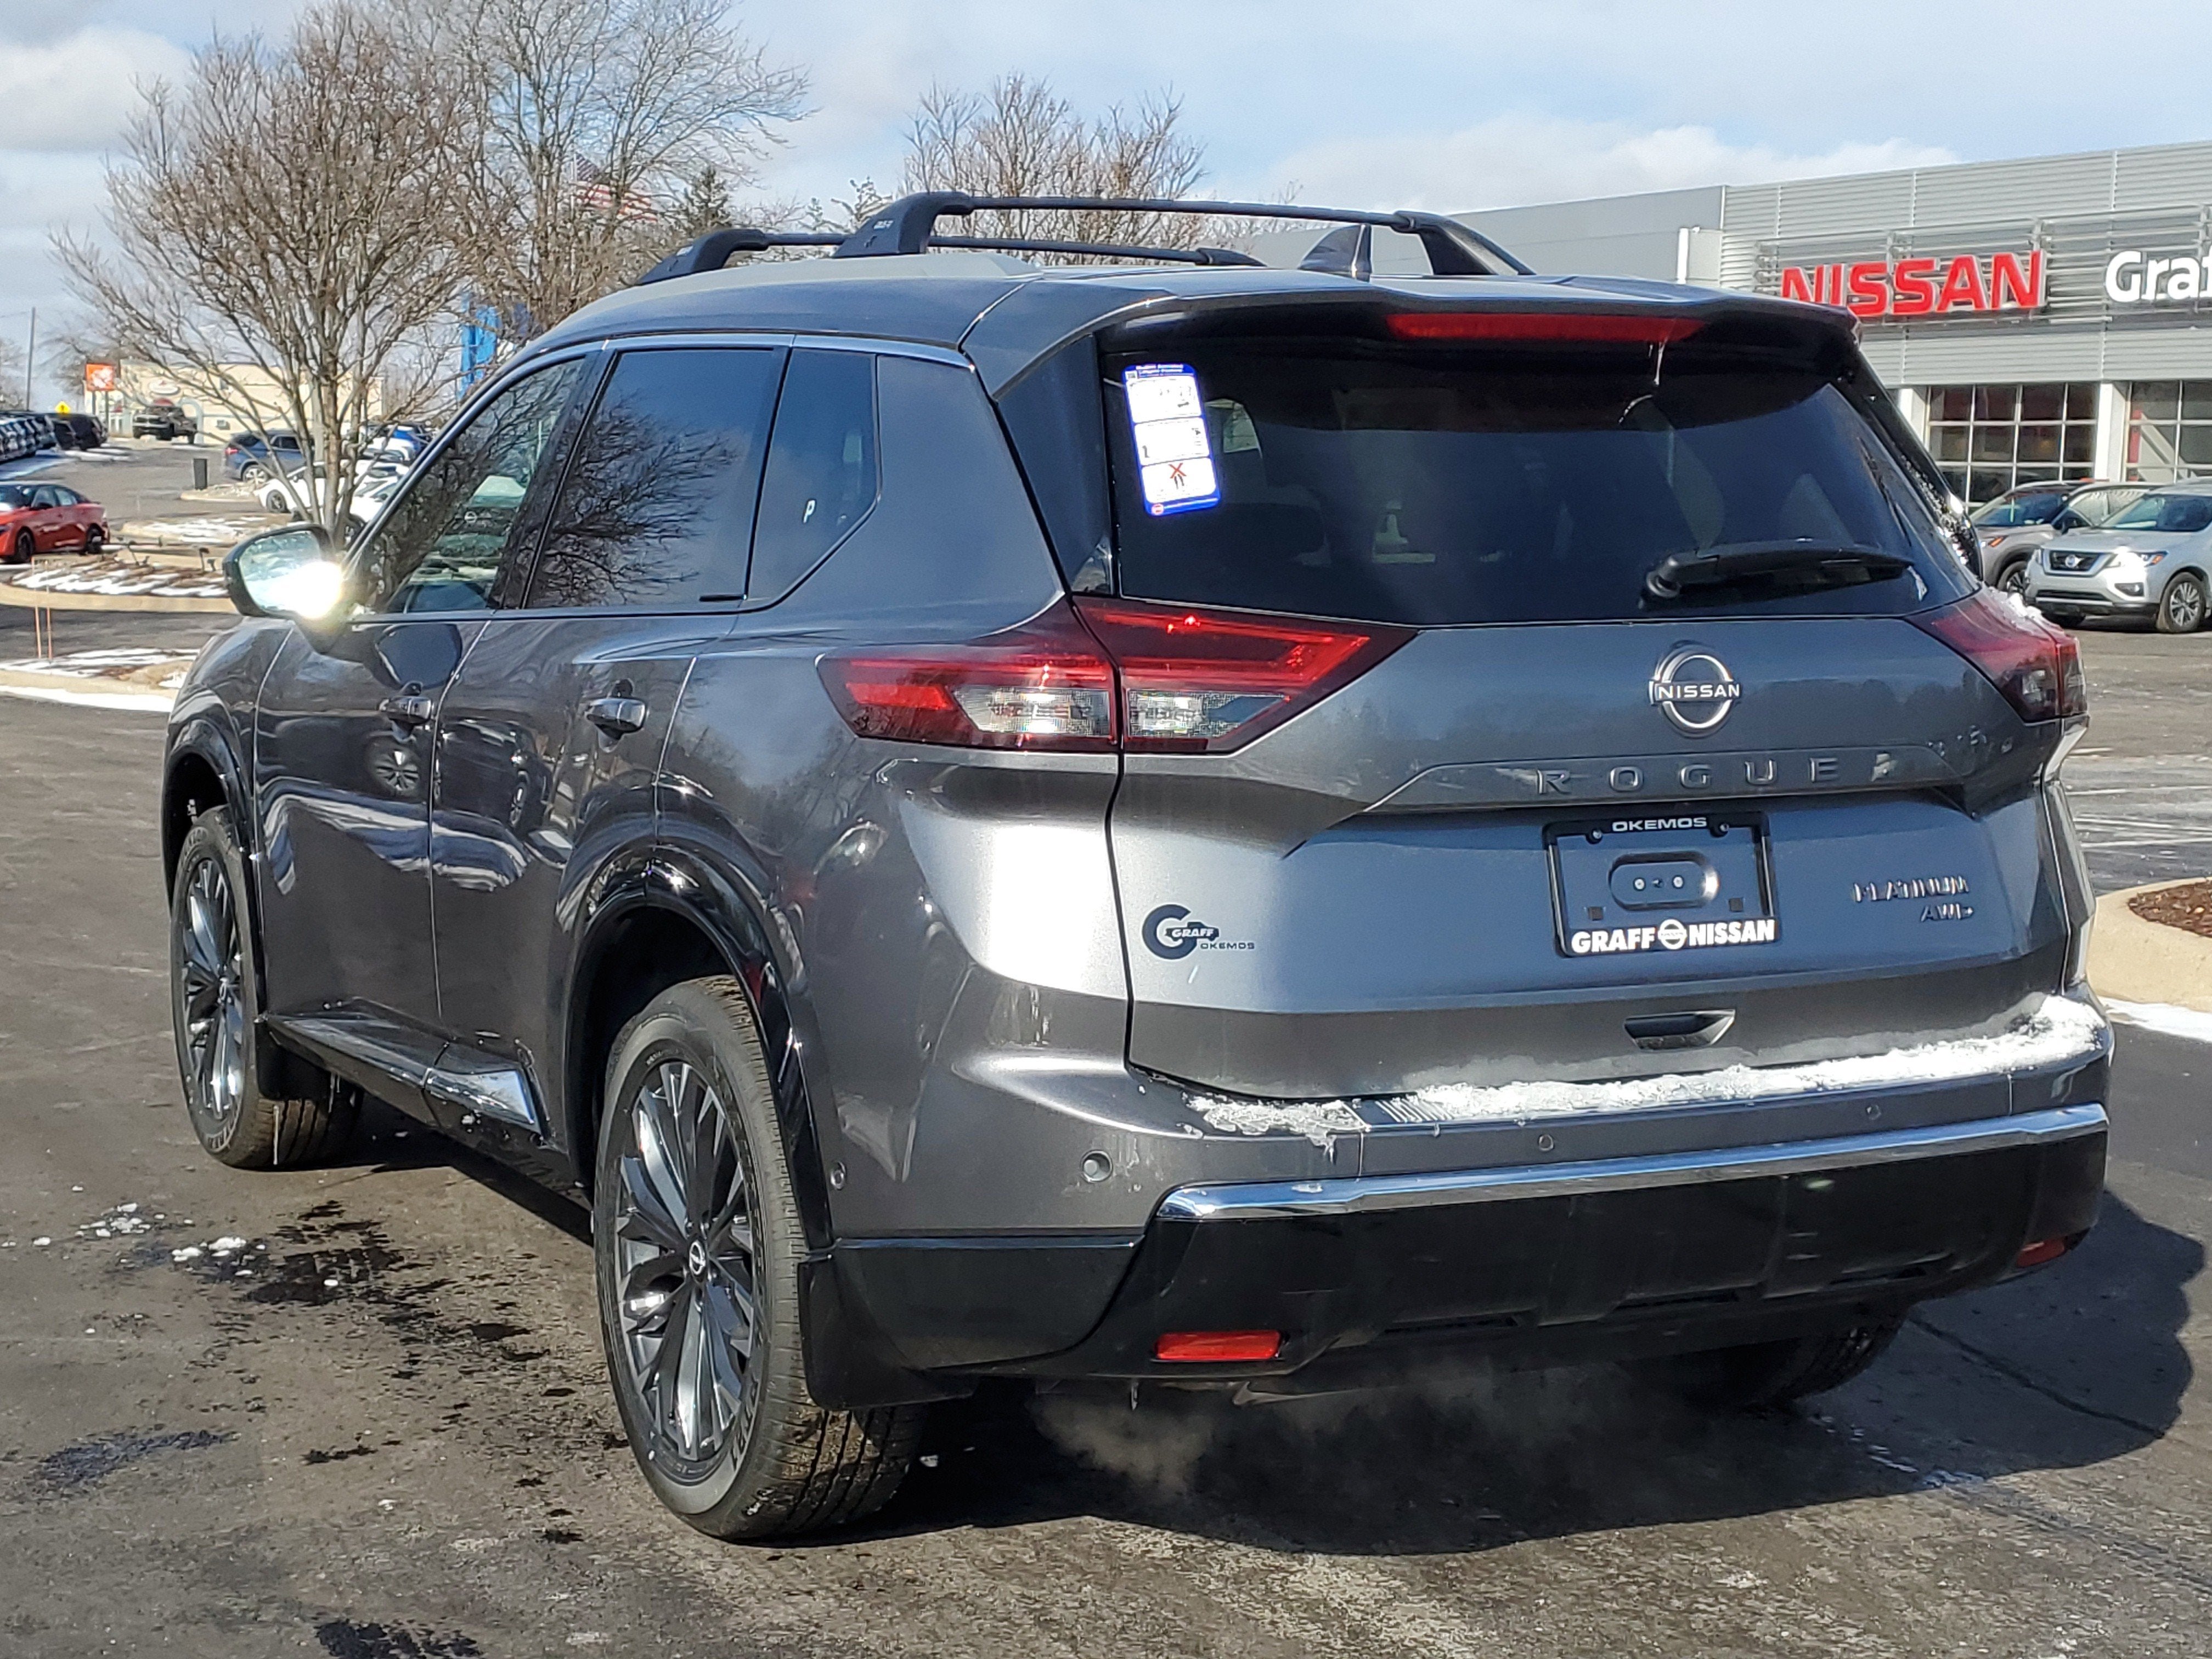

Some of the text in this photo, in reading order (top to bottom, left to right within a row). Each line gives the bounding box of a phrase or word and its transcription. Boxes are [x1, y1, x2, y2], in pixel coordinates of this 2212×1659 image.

[1780, 250, 2045, 317] NISSAN
[1658, 684, 1740, 699] NISSAN
[1537, 757, 1839, 795] ROGUE
[1612, 817, 1707, 832] OKEMOS
[1171, 928, 1214, 938] GRAFF
[1571, 919, 1776, 953] GRAFF NISSAN
[1200, 942, 1255, 950] OKEMOS
